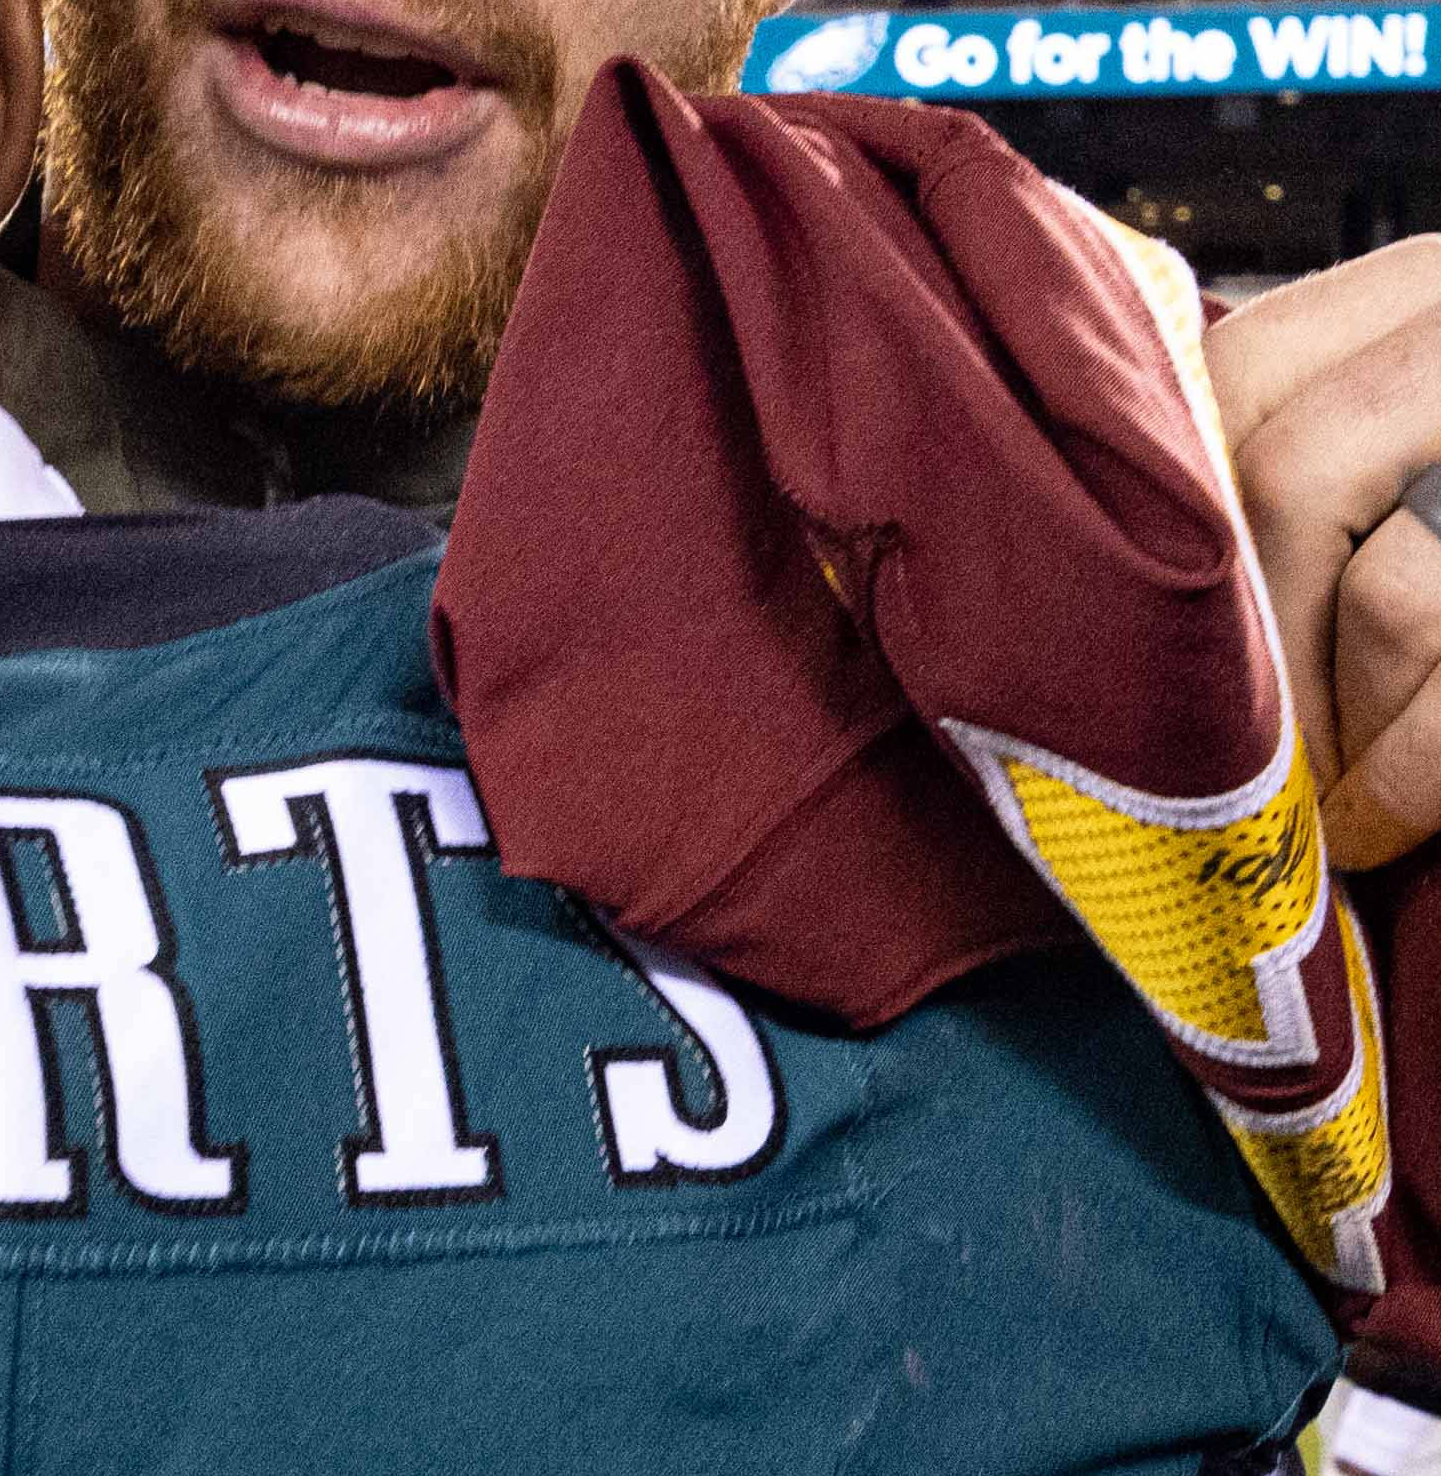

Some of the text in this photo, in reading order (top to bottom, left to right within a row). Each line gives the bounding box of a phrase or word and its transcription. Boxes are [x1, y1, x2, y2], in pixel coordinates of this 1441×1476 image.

[894, 13, 1428, 87] Go for the WIN!
